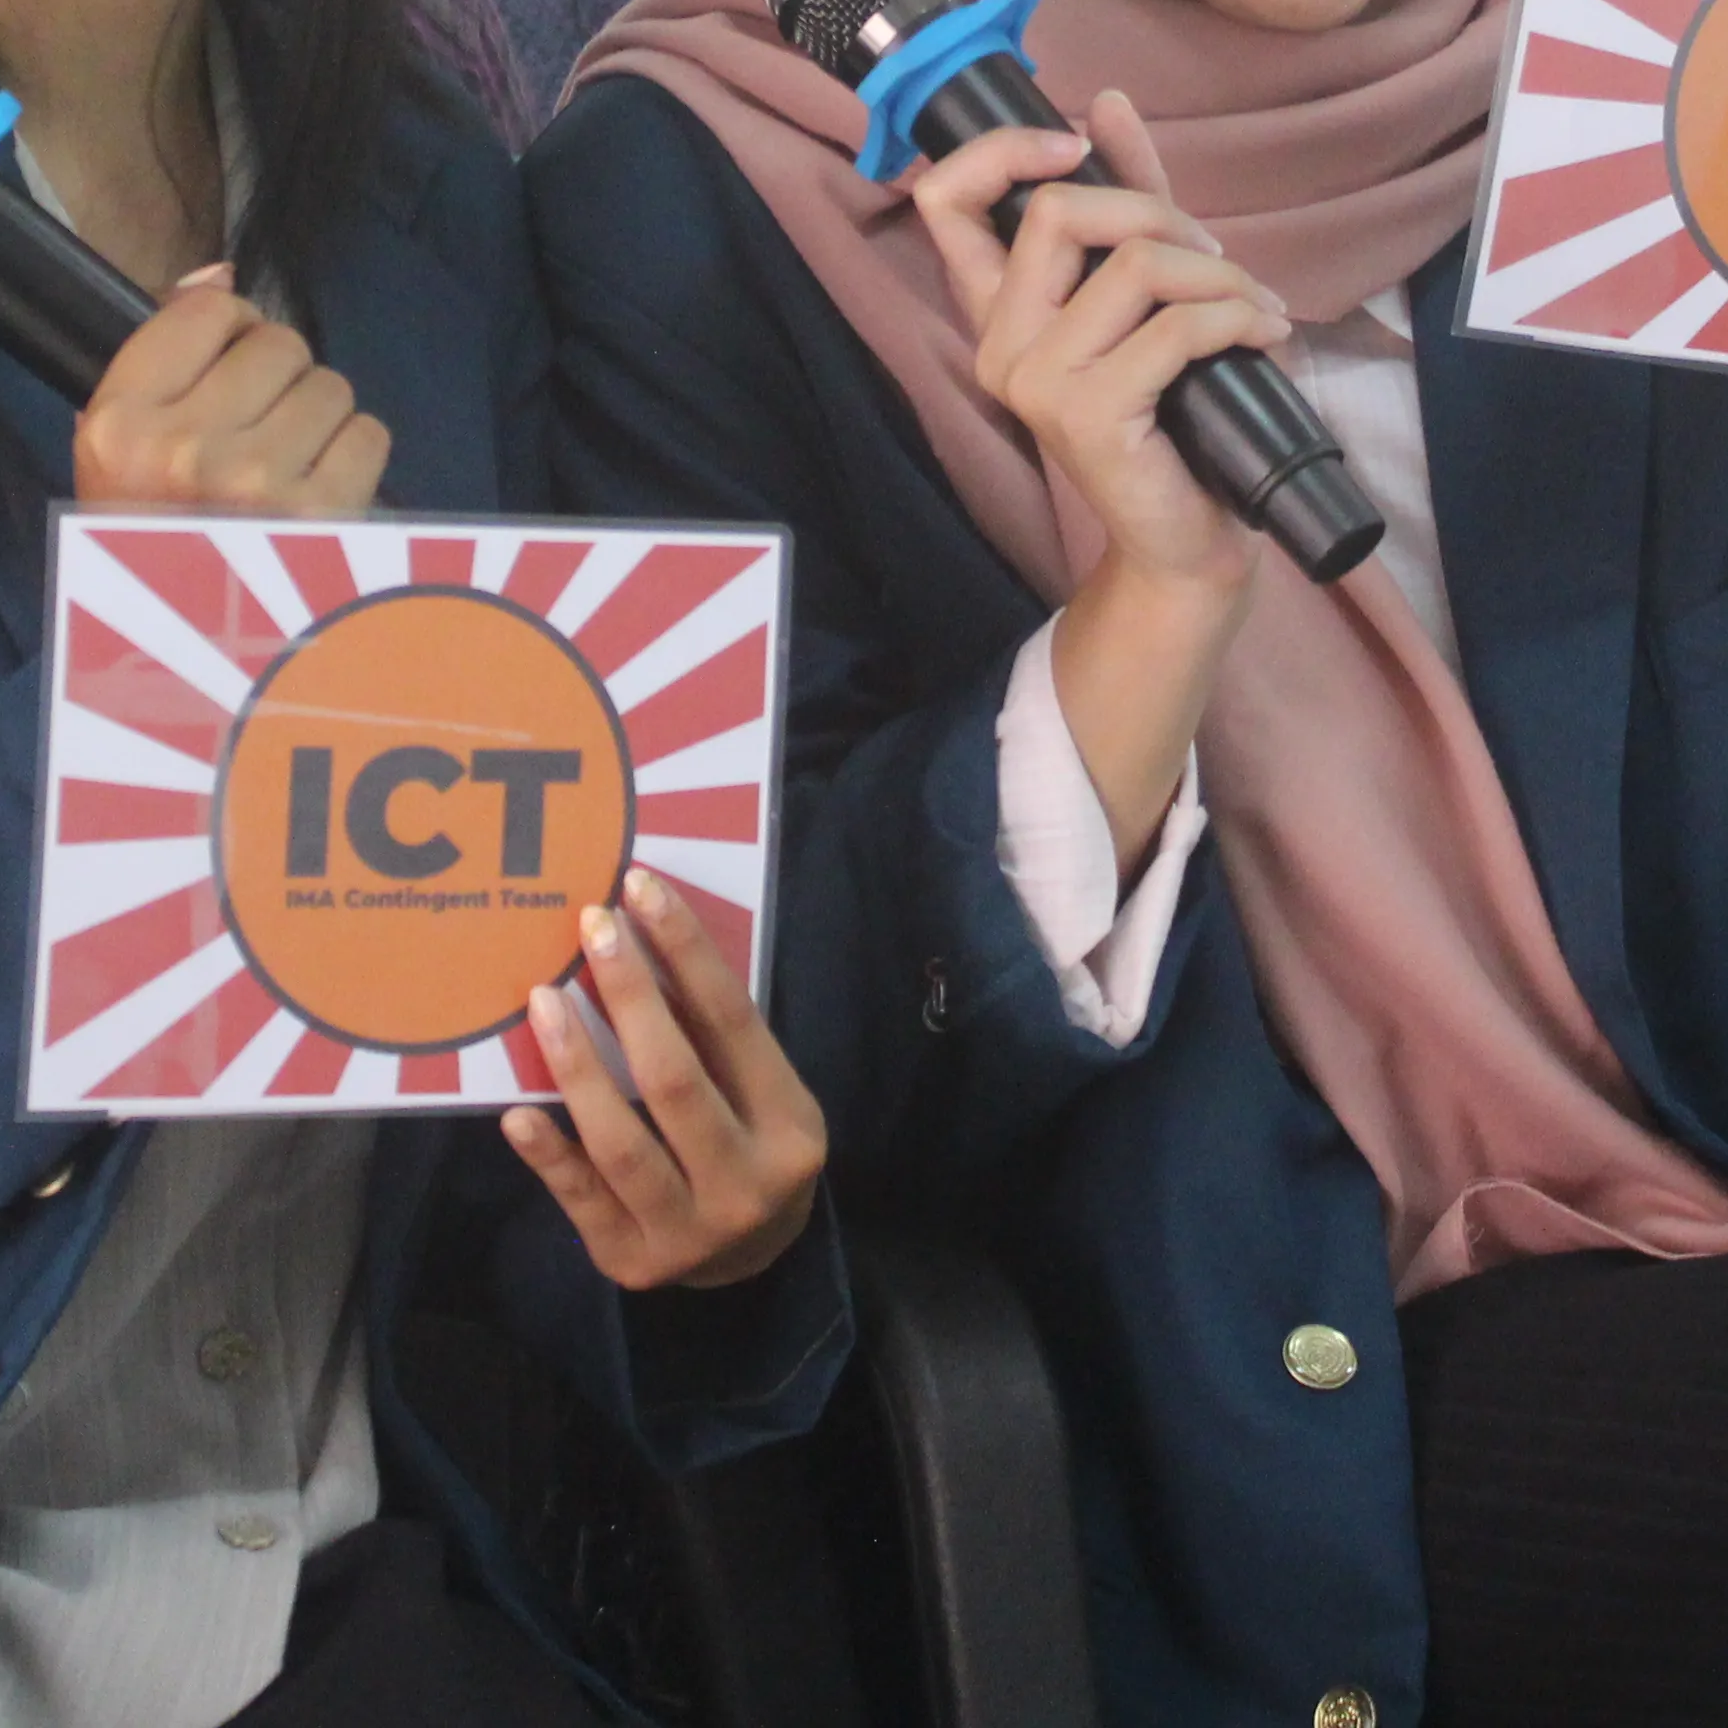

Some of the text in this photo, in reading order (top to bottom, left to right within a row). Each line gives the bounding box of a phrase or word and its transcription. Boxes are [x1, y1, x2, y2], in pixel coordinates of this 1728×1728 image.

[285, 746, 582, 880] ICT
[286, 887, 568, 913] IMA Contingent Team
